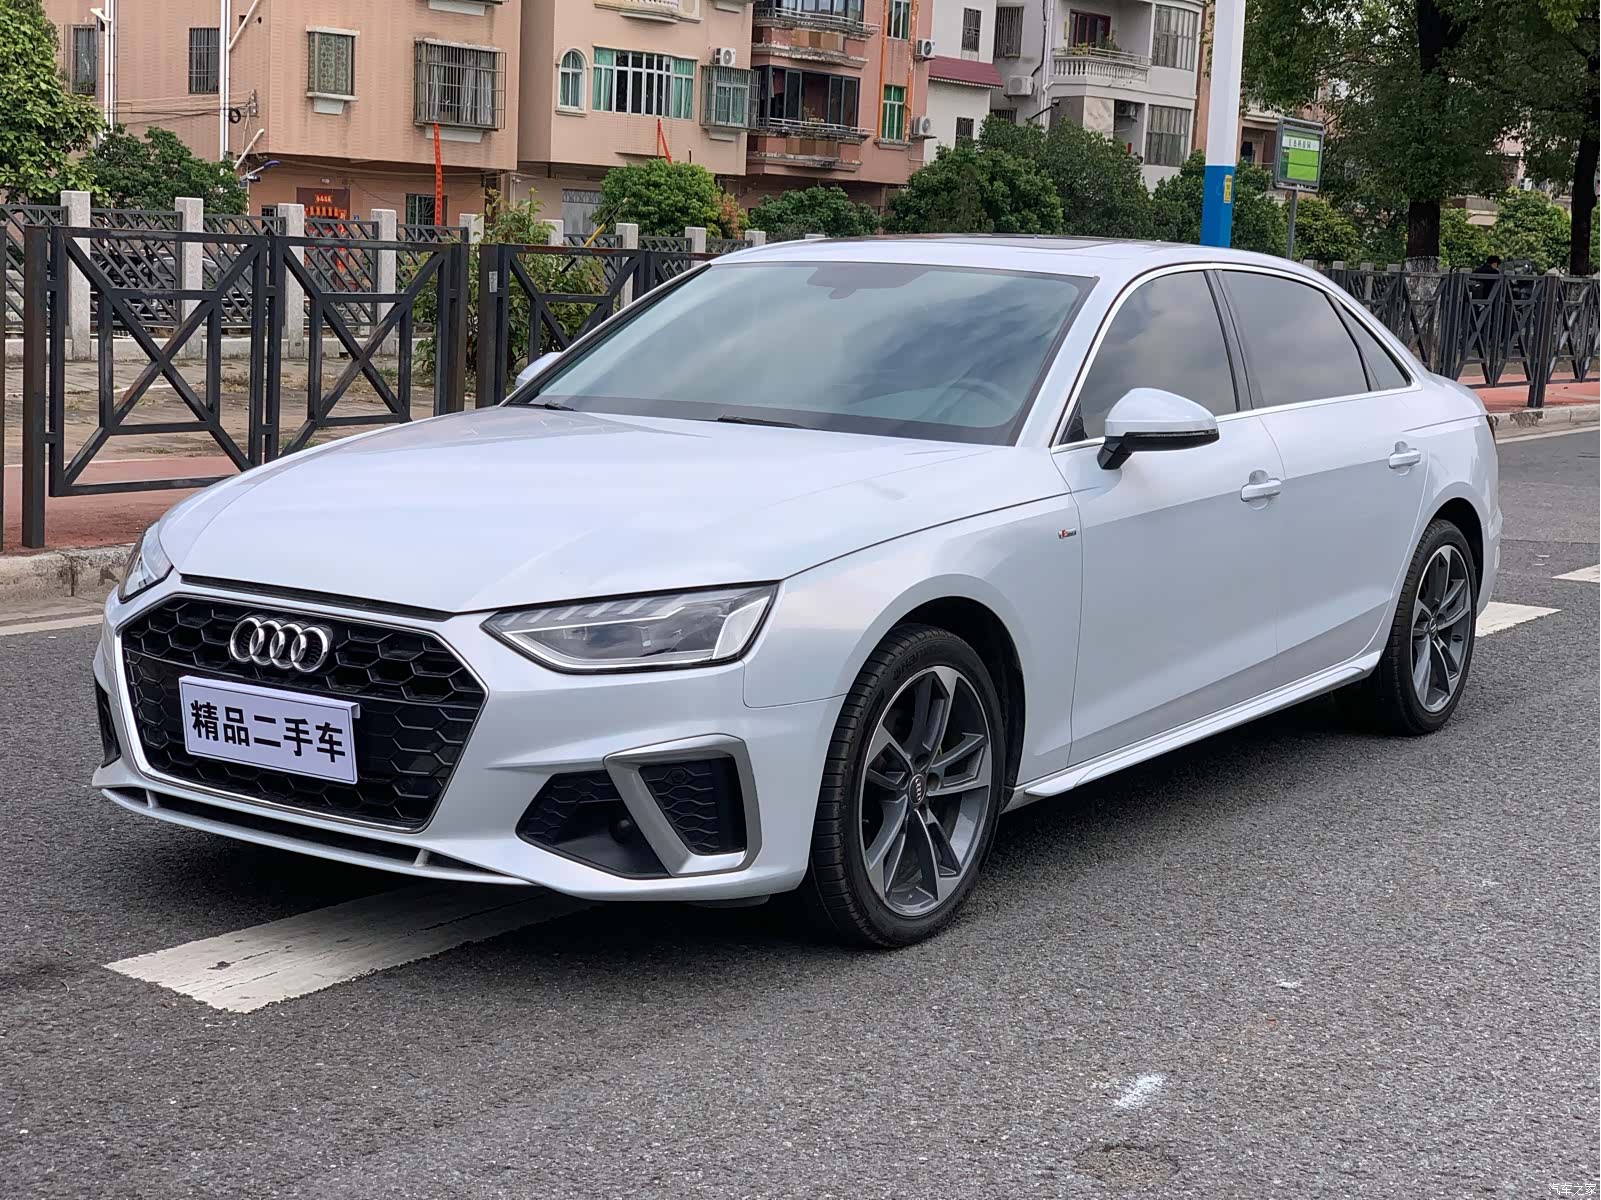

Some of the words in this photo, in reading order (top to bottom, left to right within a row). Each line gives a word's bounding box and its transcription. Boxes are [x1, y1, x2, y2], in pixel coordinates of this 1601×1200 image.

[190, 700, 346, 763] 精品二手车
